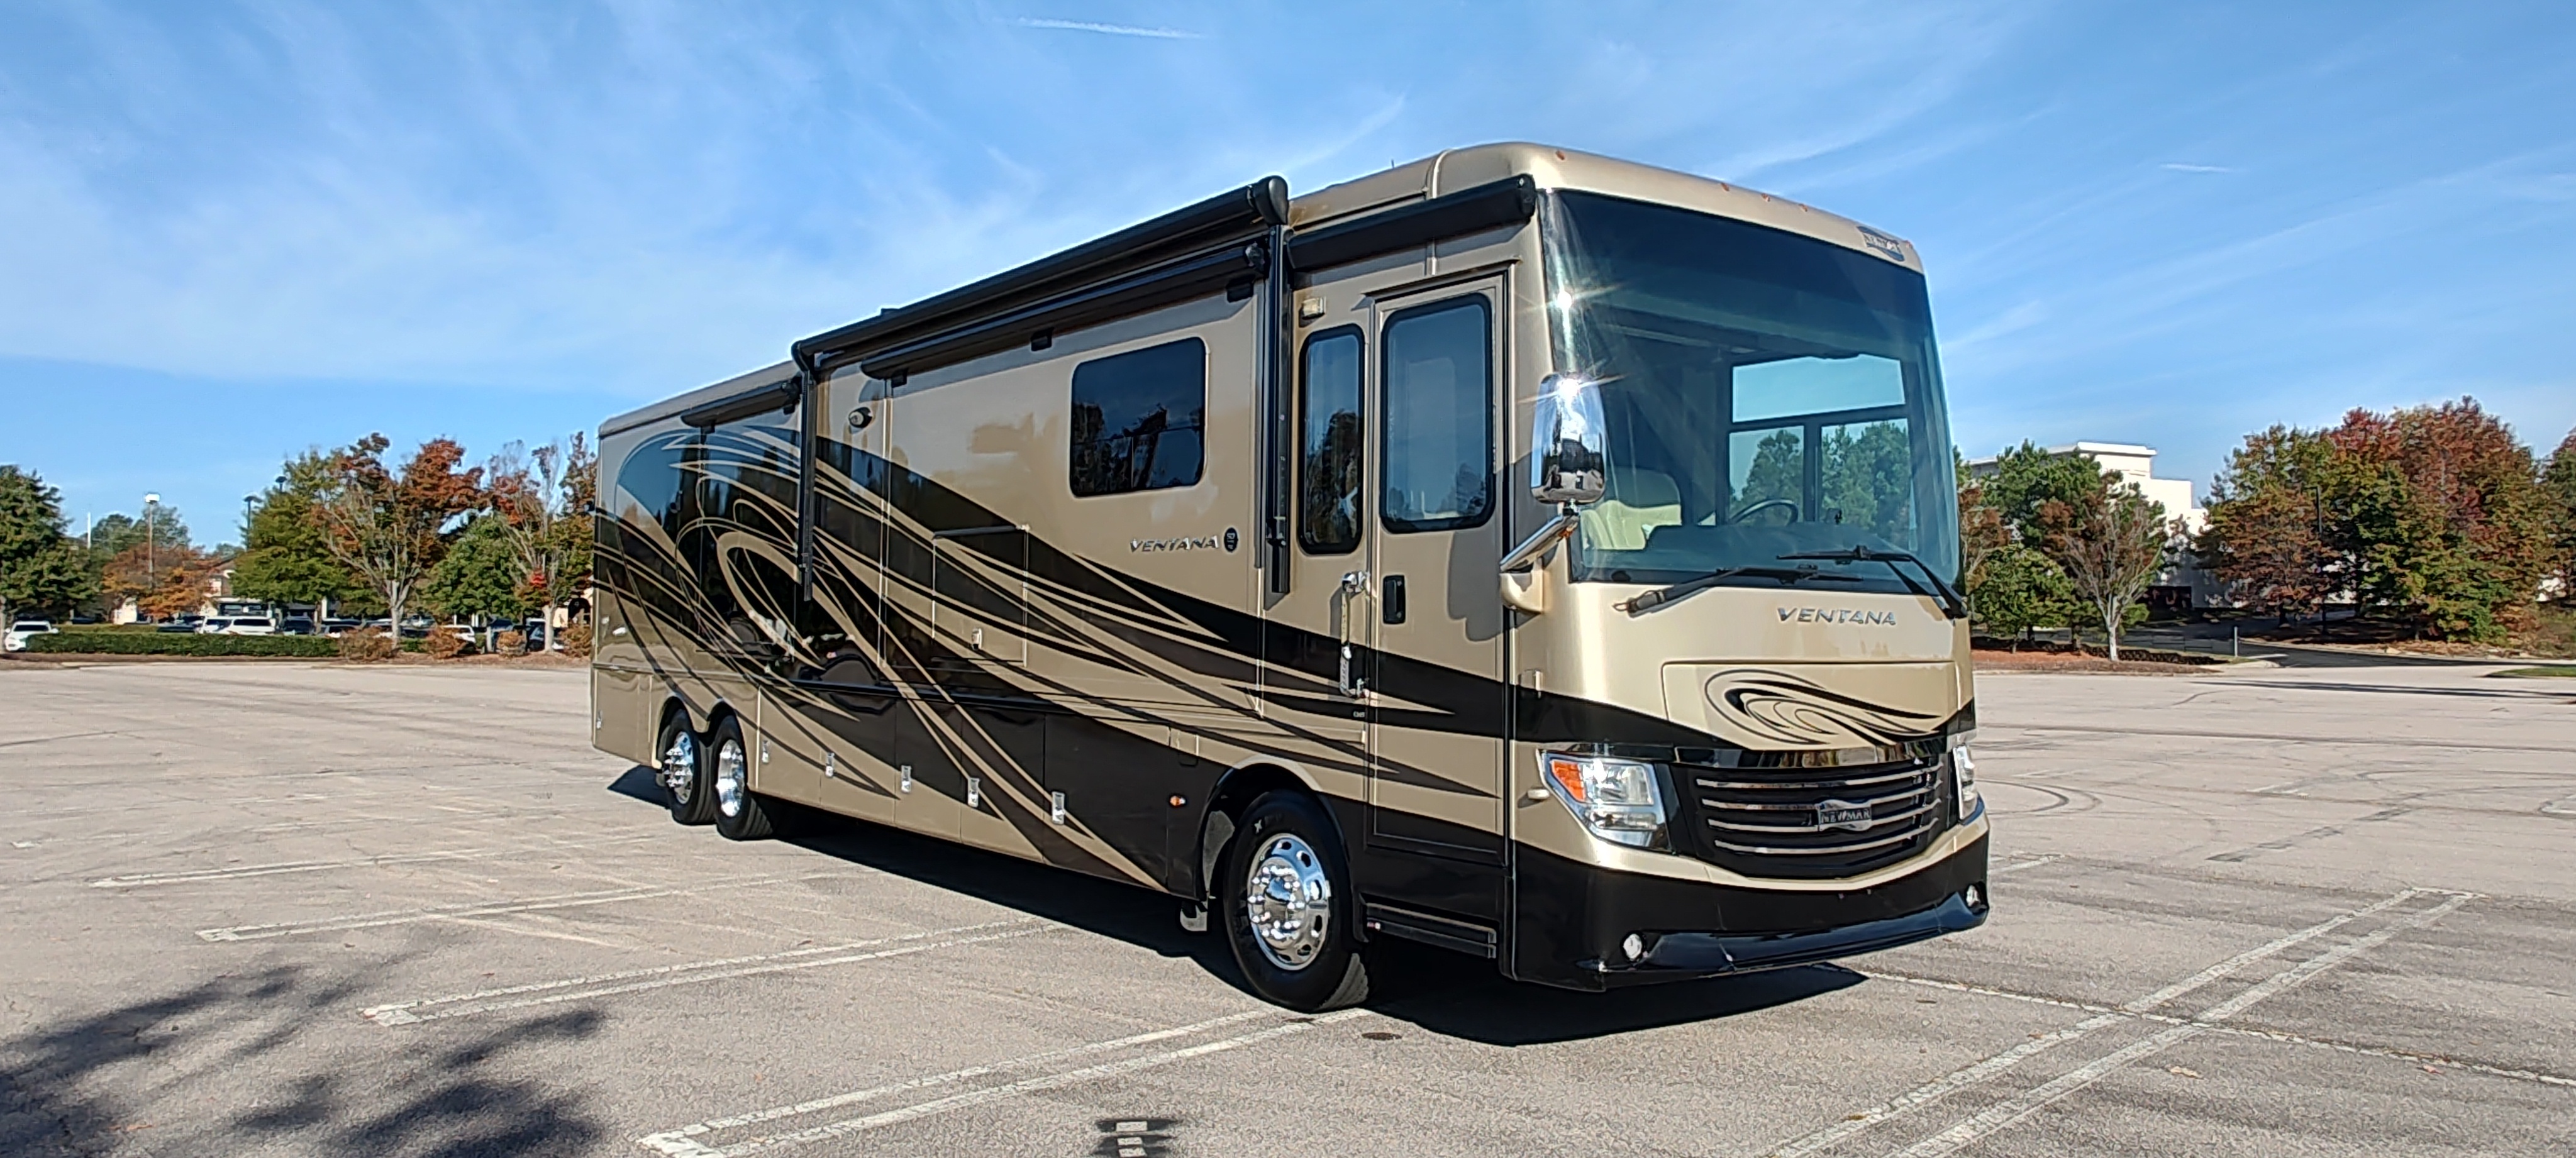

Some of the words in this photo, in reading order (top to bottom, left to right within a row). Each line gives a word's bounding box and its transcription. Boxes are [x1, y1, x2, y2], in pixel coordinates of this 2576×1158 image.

[1130, 536, 1219, 553] VENTANA
[1777, 607, 1896, 626] VENTANA
[1822, 809, 1870, 824] NEWMAR
